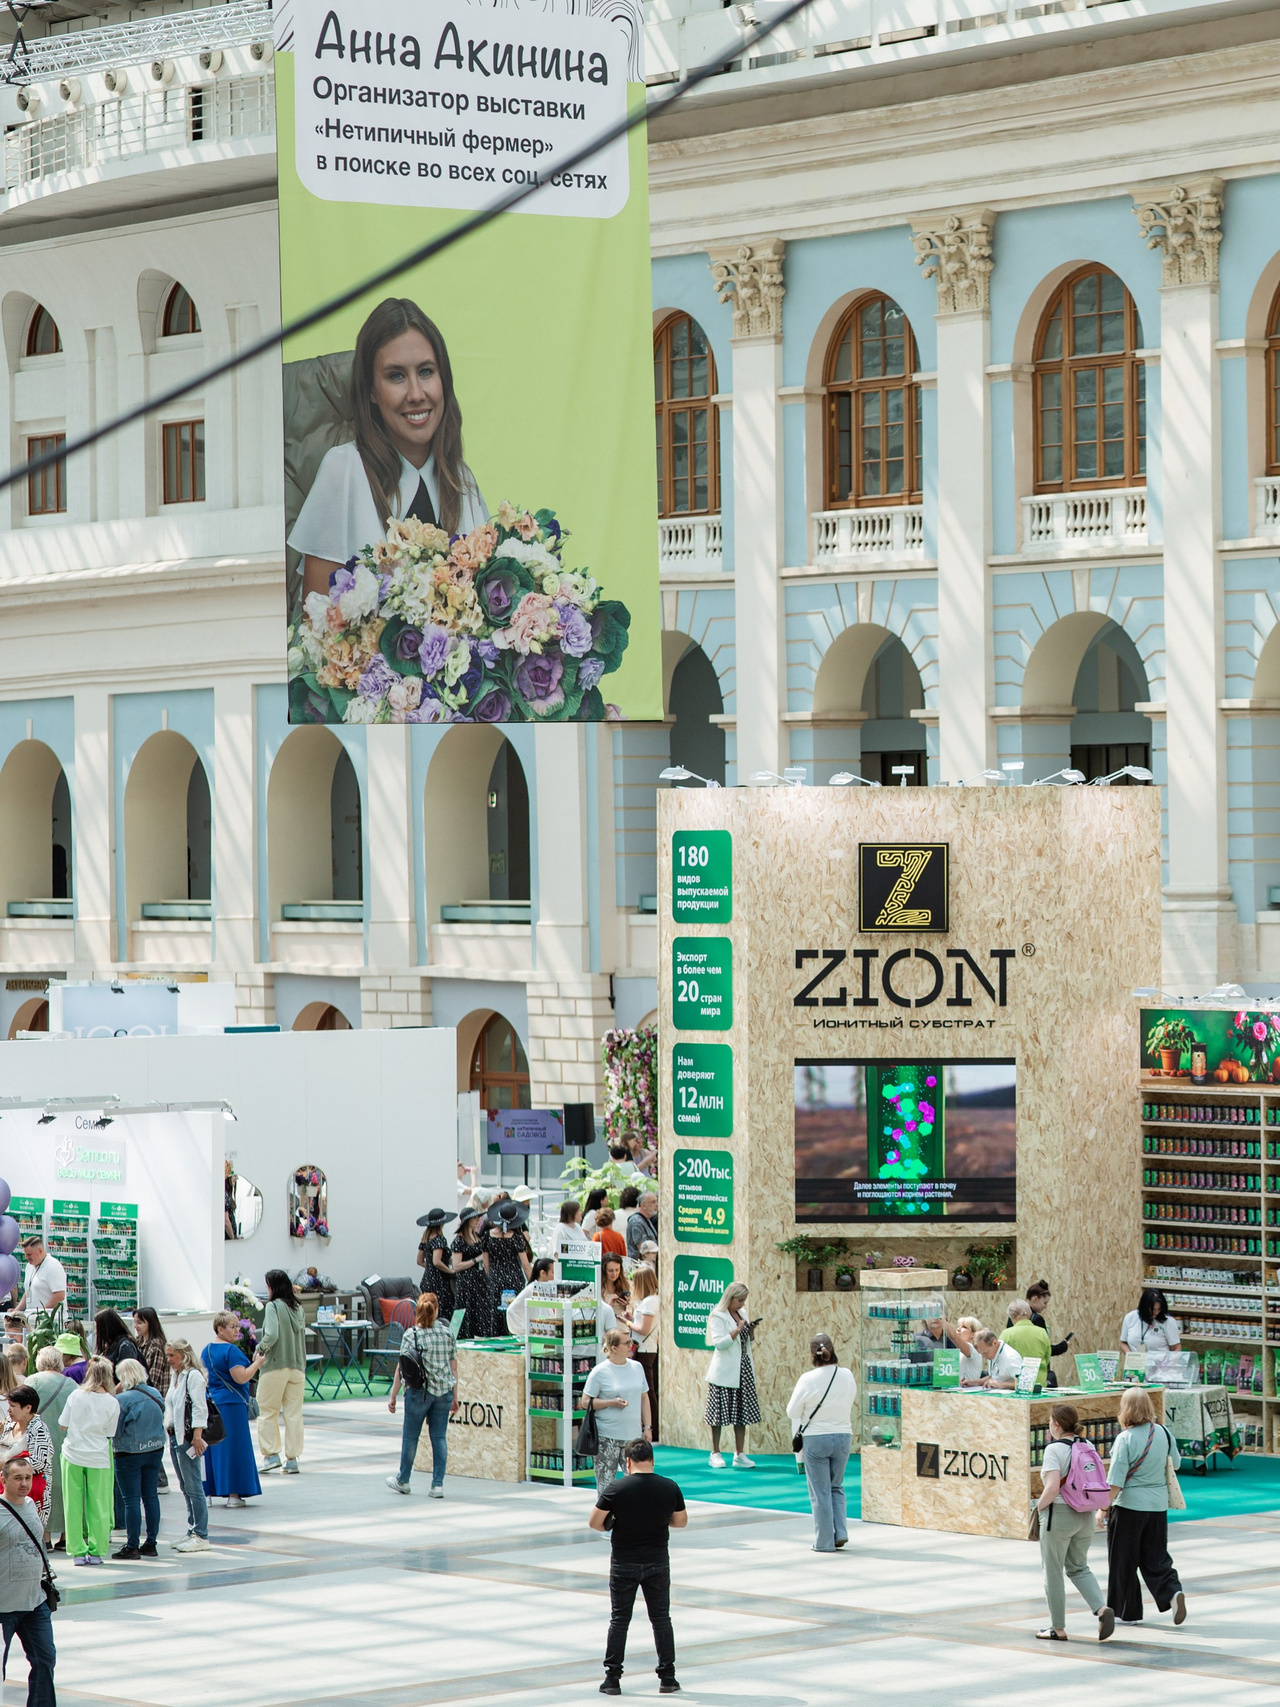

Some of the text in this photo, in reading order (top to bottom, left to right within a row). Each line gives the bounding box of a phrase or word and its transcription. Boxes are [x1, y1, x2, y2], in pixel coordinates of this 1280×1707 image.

[314, 10, 609, 86] Анна Акинина
[312, 75, 586, 121] Организатор выставки
[315, 118, 554, 158] «Нетипичный фермер»
[317, 154, 327, 170] в
[334, 157, 411, 177] поиске
[418, 163, 442, 179] во
[449, 164, 496, 183] всех
[551, 172, 608, 190] сетях
[678, 845, 709, 867] 180
[677, 874, 701, 884] видов
[677, 885, 729, 897] выпускаемой
[677, 899, 719, 910] продукции
[677, 952, 707, 965] Экспорт
[677, 963, 722, 975] в более чем
[677, 980, 722, 1004] 20 стран
[700, 1007, 721, 1017] мира
[677, 1055, 694, 1066] Нам
[677, 1069, 715, 1081] доверяют
[678, 1086, 698, 1108] 12
[677, 1113, 701, 1124] семей
[853, 1181, 872, 1190] Далее
[873, 1182, 902, 1190] элементы
[903, 1182, 933, 1191] поступают
[940, 1183, 957, 1191] почву
[862, 1191, 901, 1199] поглощаются
[902, 1191, 924, 1199] корнем
[678, 1205, 702, 1215] Средняя
[703, 1207, 726, 1226] 4.9
[568, 1244, 586, 1252] ZION
[678, 1280, 689, 1293] До
[688, 1269, 699, 1292] 7
[678, 1313, 683, 1321] в
[938, 1363, 953, 1376] 30
[1083, 1368, 1096, 1382] 30
[943, 1449, 1009, 1481] ZION
